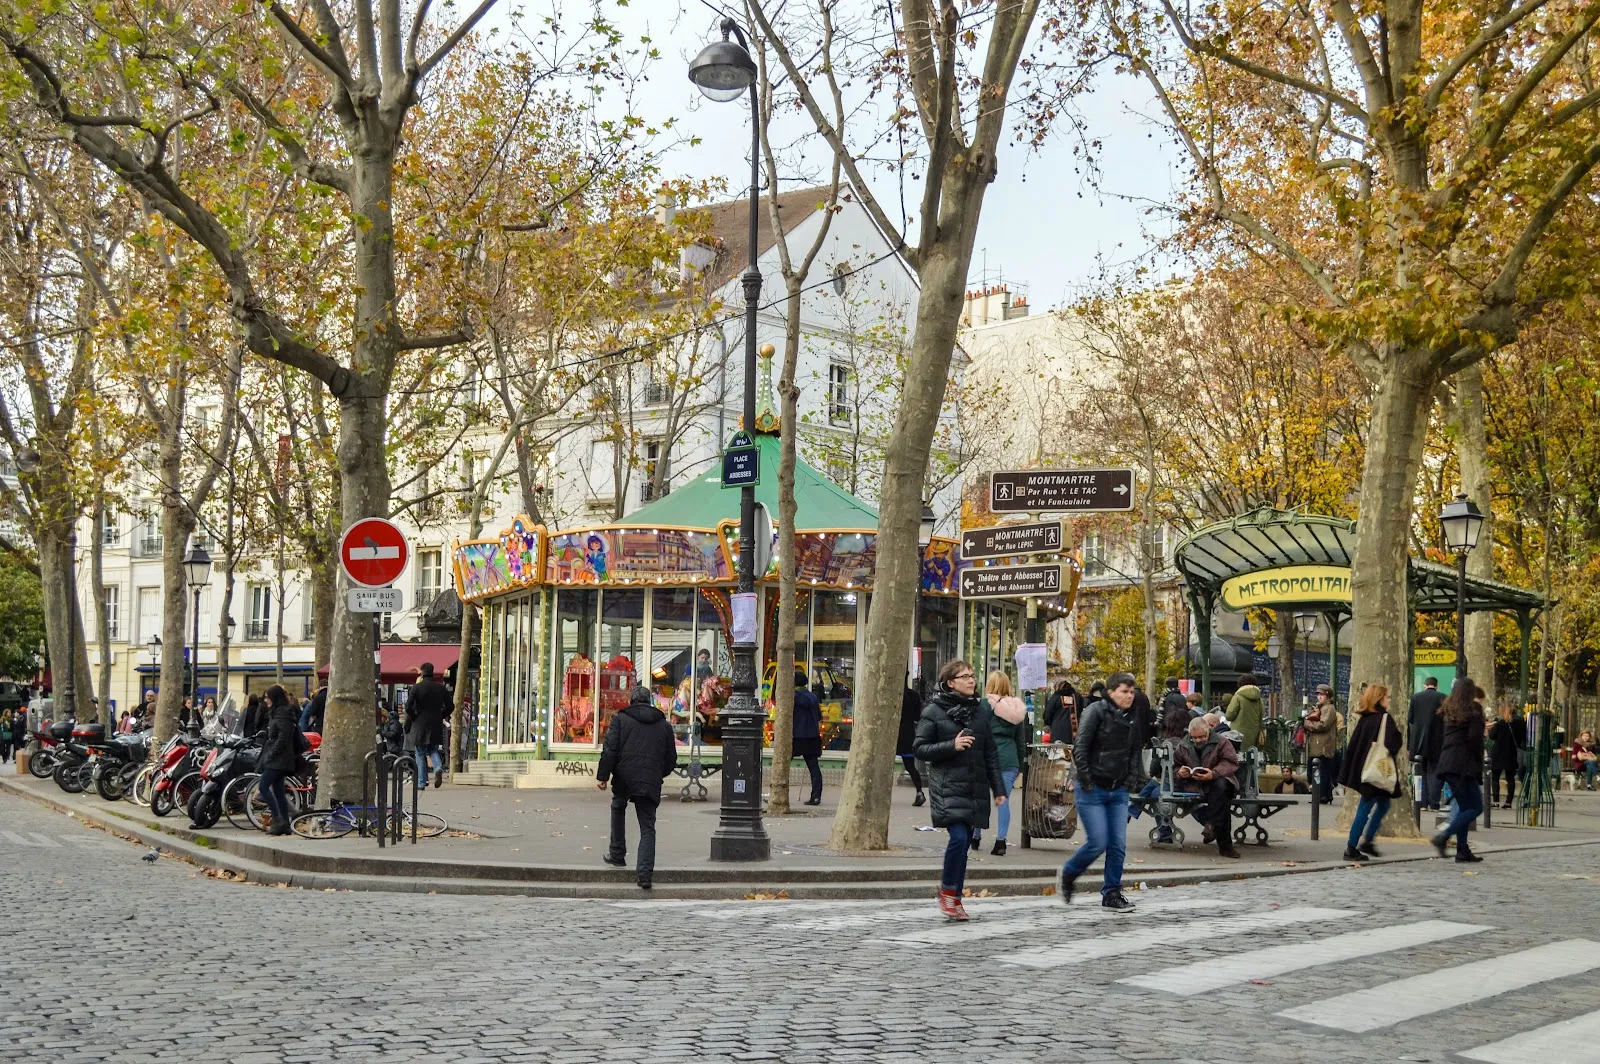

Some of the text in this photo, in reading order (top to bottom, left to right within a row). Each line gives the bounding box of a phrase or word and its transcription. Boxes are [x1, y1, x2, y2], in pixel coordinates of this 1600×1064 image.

[734, 455, 748, 463] PLACE
[729, 470, 752, 478] ABBESSES
[1028, 475, 1095, 485] MONTMARTRE
[1047, 498, 1091, 506] Funiculaire
[995, 528, 1043, 541] MONTMARTRE
[1005, 542, 1016, 550] Rue
[1017, 541, 1034, 549] LEPIC
[1001, 573, 1012, 581] des
[1015, 571, 1043, 580] Abbesses
[1009, 583, 1035, 591] Abbesses
[1239, 577, 1352, 599] METROPOLITAI
